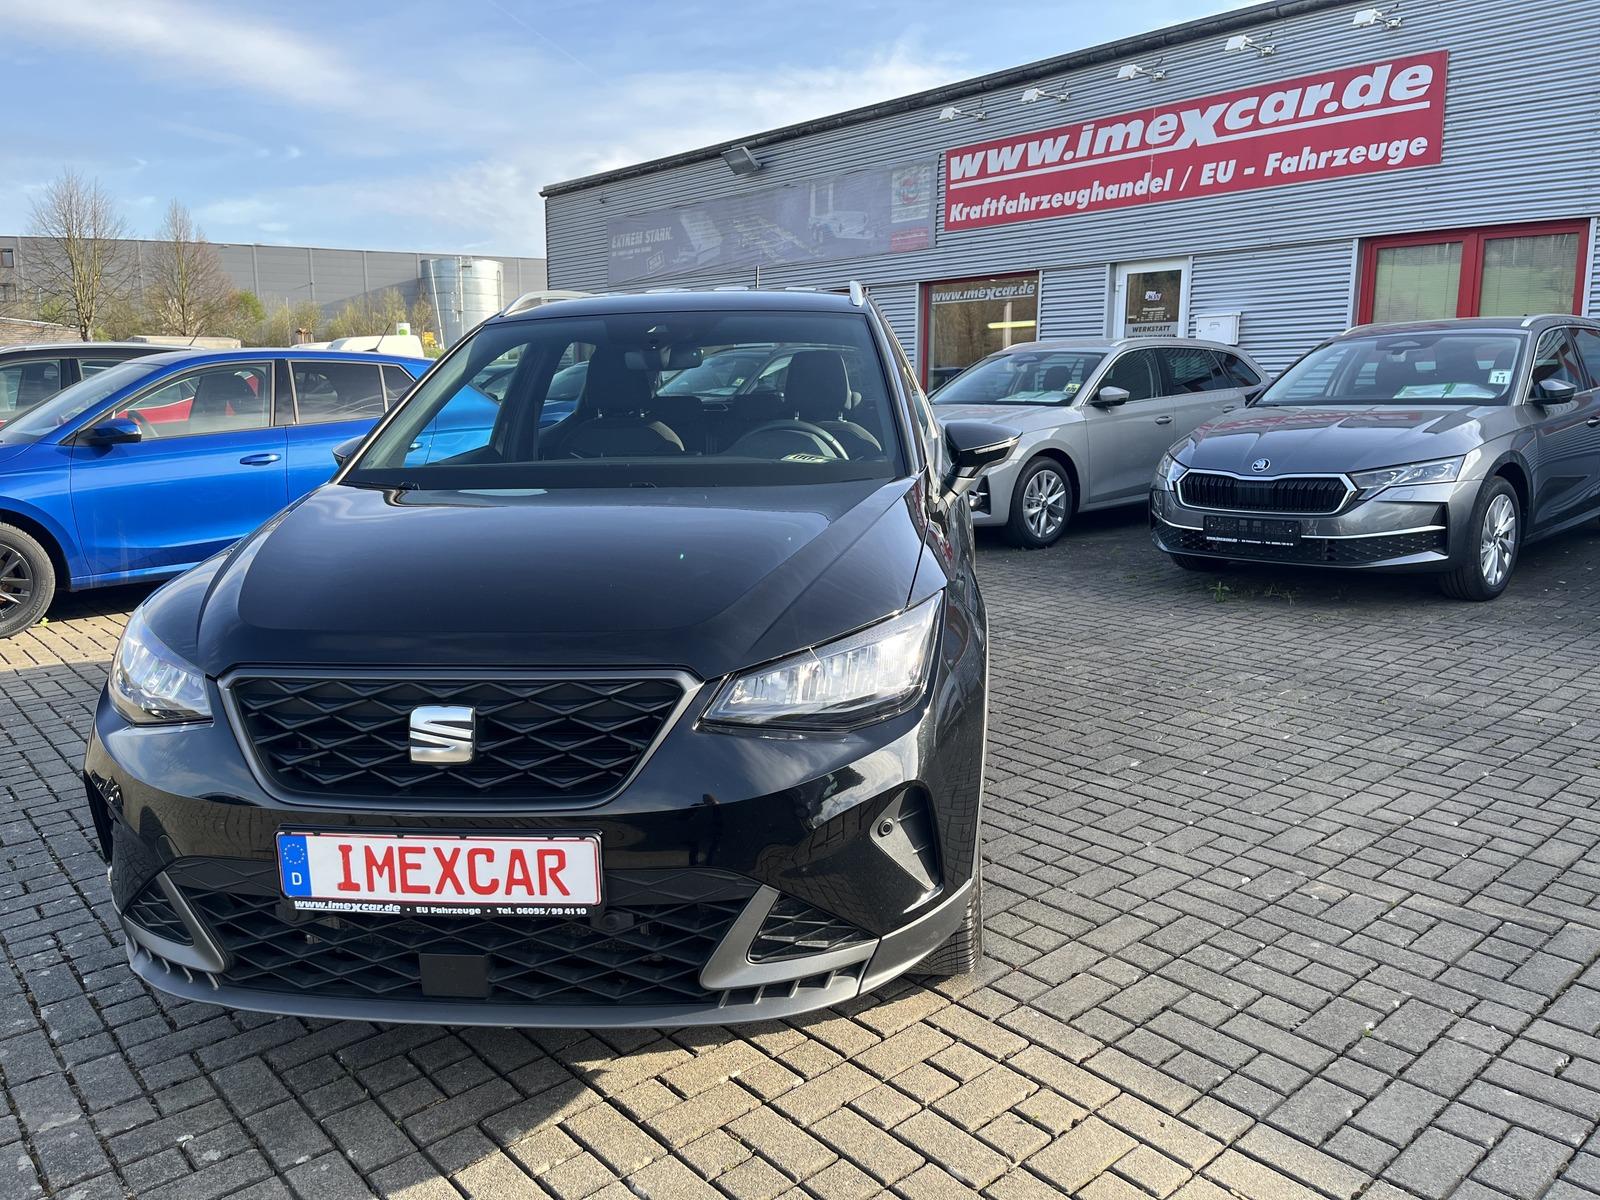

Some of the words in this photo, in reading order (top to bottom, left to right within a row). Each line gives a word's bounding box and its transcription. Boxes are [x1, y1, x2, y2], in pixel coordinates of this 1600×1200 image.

[949, 63, 1434, 181] www.imexcar.de
[949, 168, 1174, 223] Kraftfahrzeughandel
[1199, 159, 1237, 186] EU
[1264, 136, 1428, 177] Fahrzeuge
[1132, 325, 1171, 333] WERKSTATT
[291, 872, 303, 886] D
[337, 844, 571, 897] IMEXCAR
[415, 906, 429, 914] EU
[430, 906, 481, 916] Fahrzeuge
[496, 906, 515, 915] Tel.
